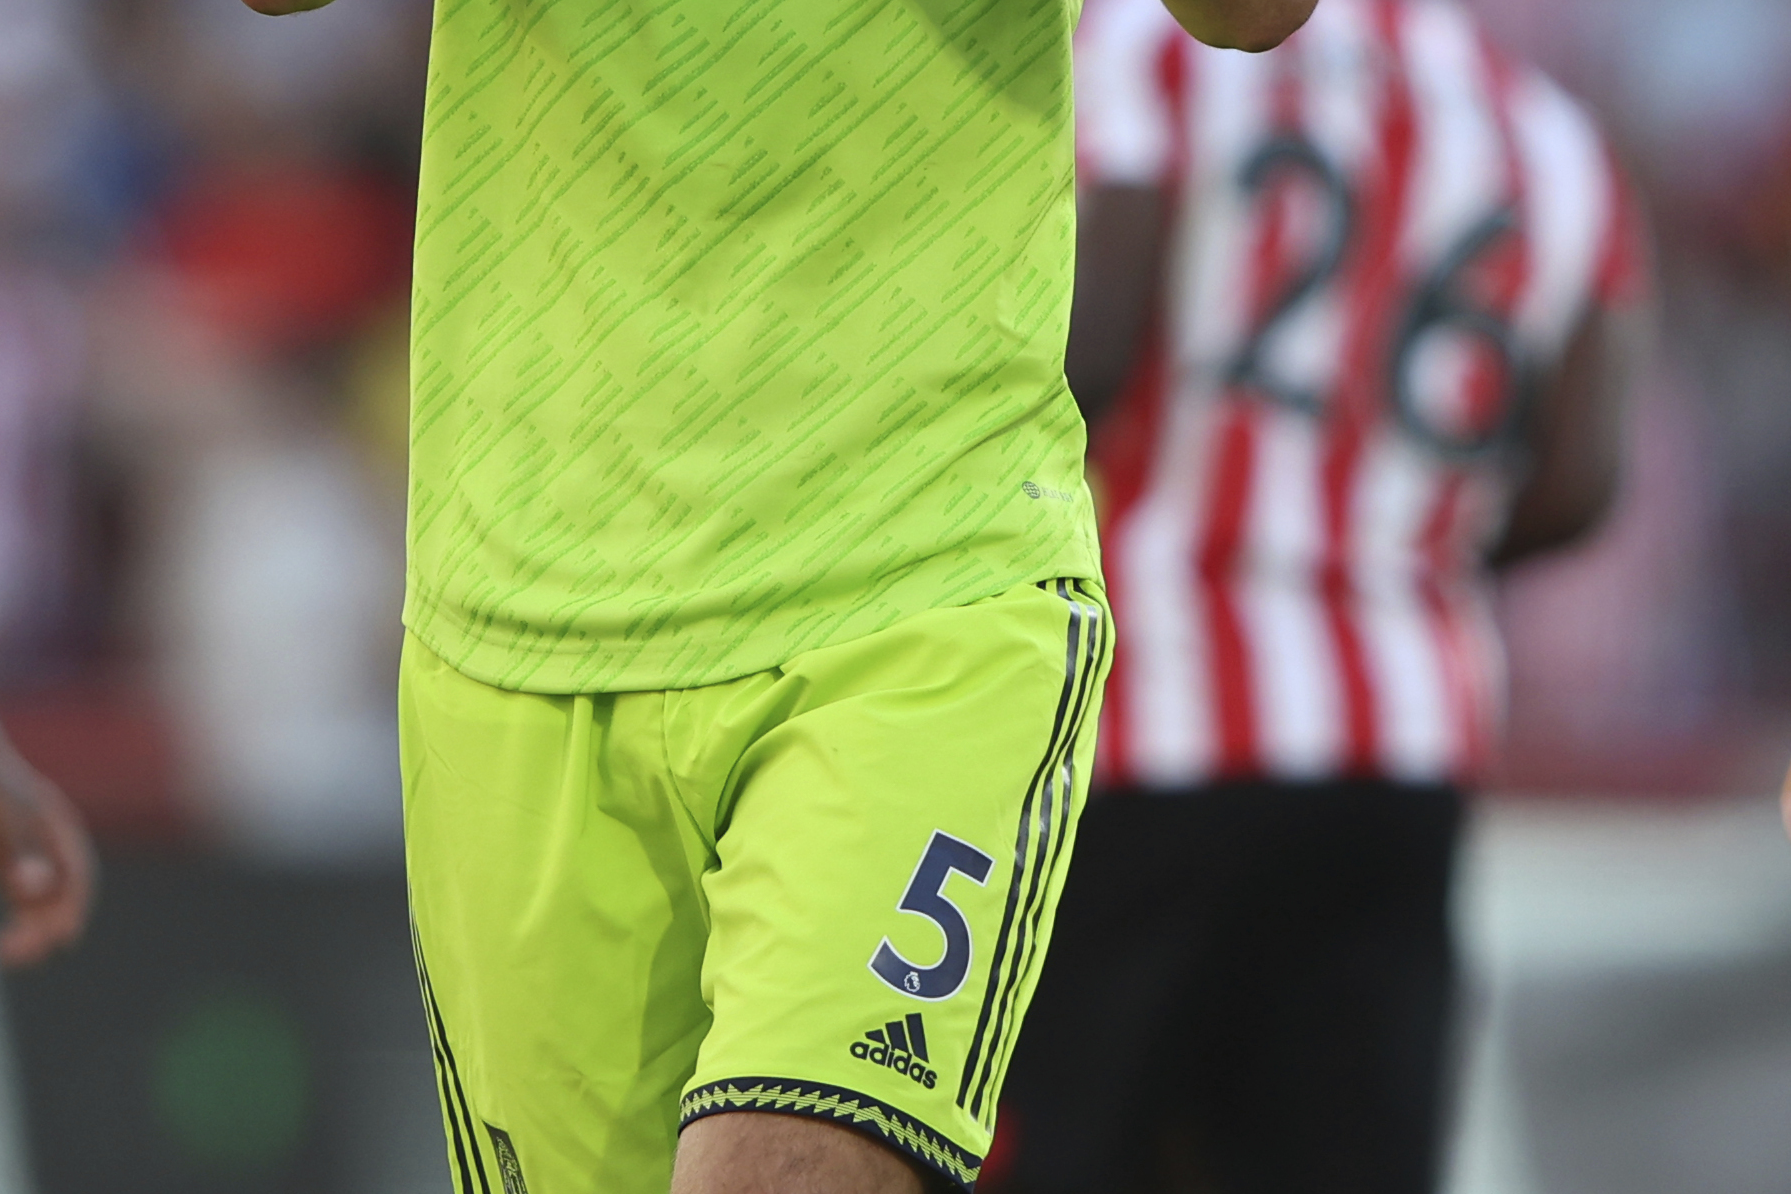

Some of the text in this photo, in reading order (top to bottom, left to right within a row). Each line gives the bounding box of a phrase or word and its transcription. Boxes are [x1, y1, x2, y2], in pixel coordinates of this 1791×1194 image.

[1224, 134, 1529, 460] 26
[866, 828, 996, 1002] 5
[849, 1041, 938, 1090] adidas
